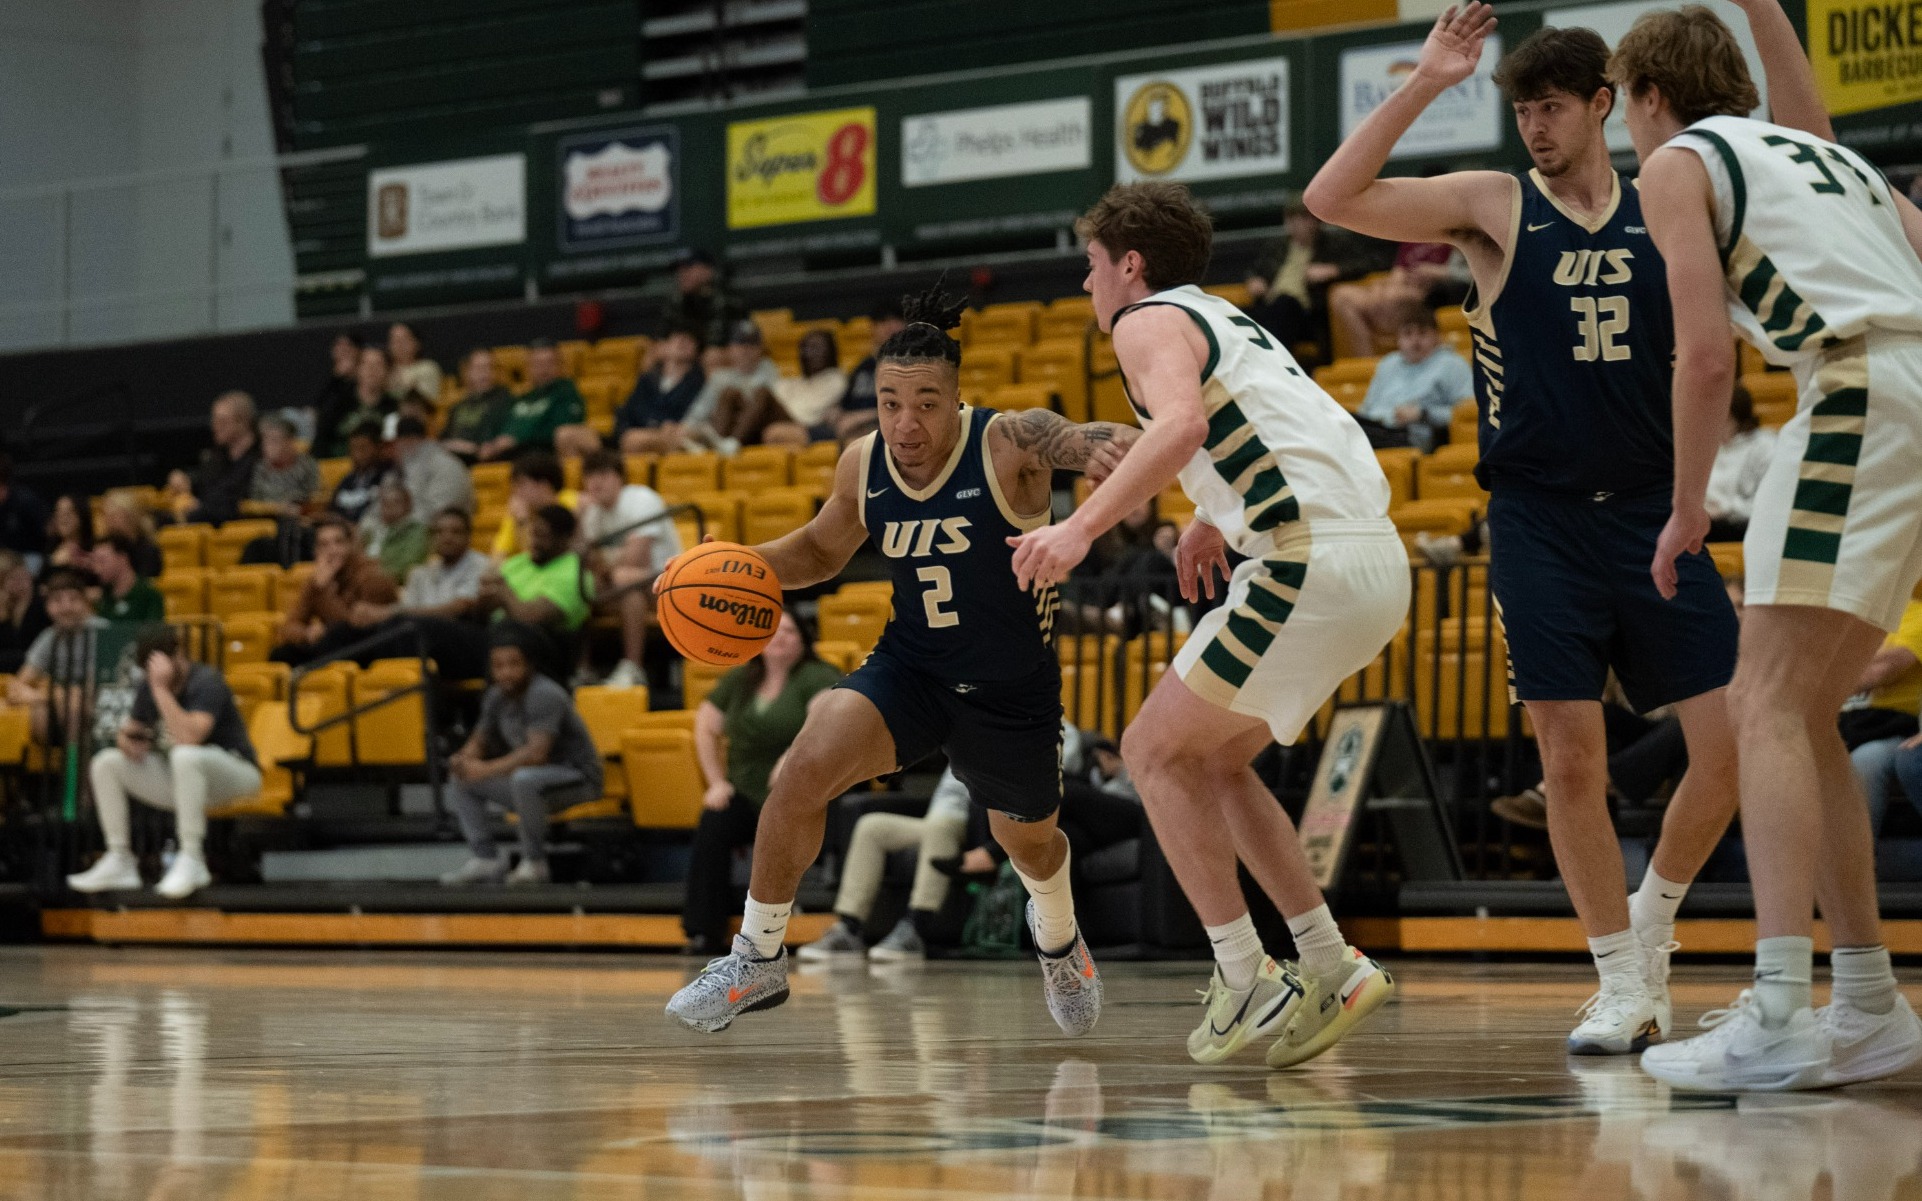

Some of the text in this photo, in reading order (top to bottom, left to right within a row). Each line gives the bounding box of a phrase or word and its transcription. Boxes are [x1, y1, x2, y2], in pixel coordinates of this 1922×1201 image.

[1829, 2, 1922, 57] DICKE
[1201, 74, 1279, 99] BUFFALO
[1020, 120, 1082, 147] Health
[1202, 98, 1279, 132] WILD
[736, 121, 868, 206] Super 8
[1203, 133, 1279, 160] WINGS
[1552, 248, 1636, 287] UIS
[1570, 294, 1632, 363] 32
[955, 487, 982, 500] GLVC
[882, 515, 974, 559] UIS
[698, 593, 774, 630] Wilson
[915, 565, 960, 630] 2
